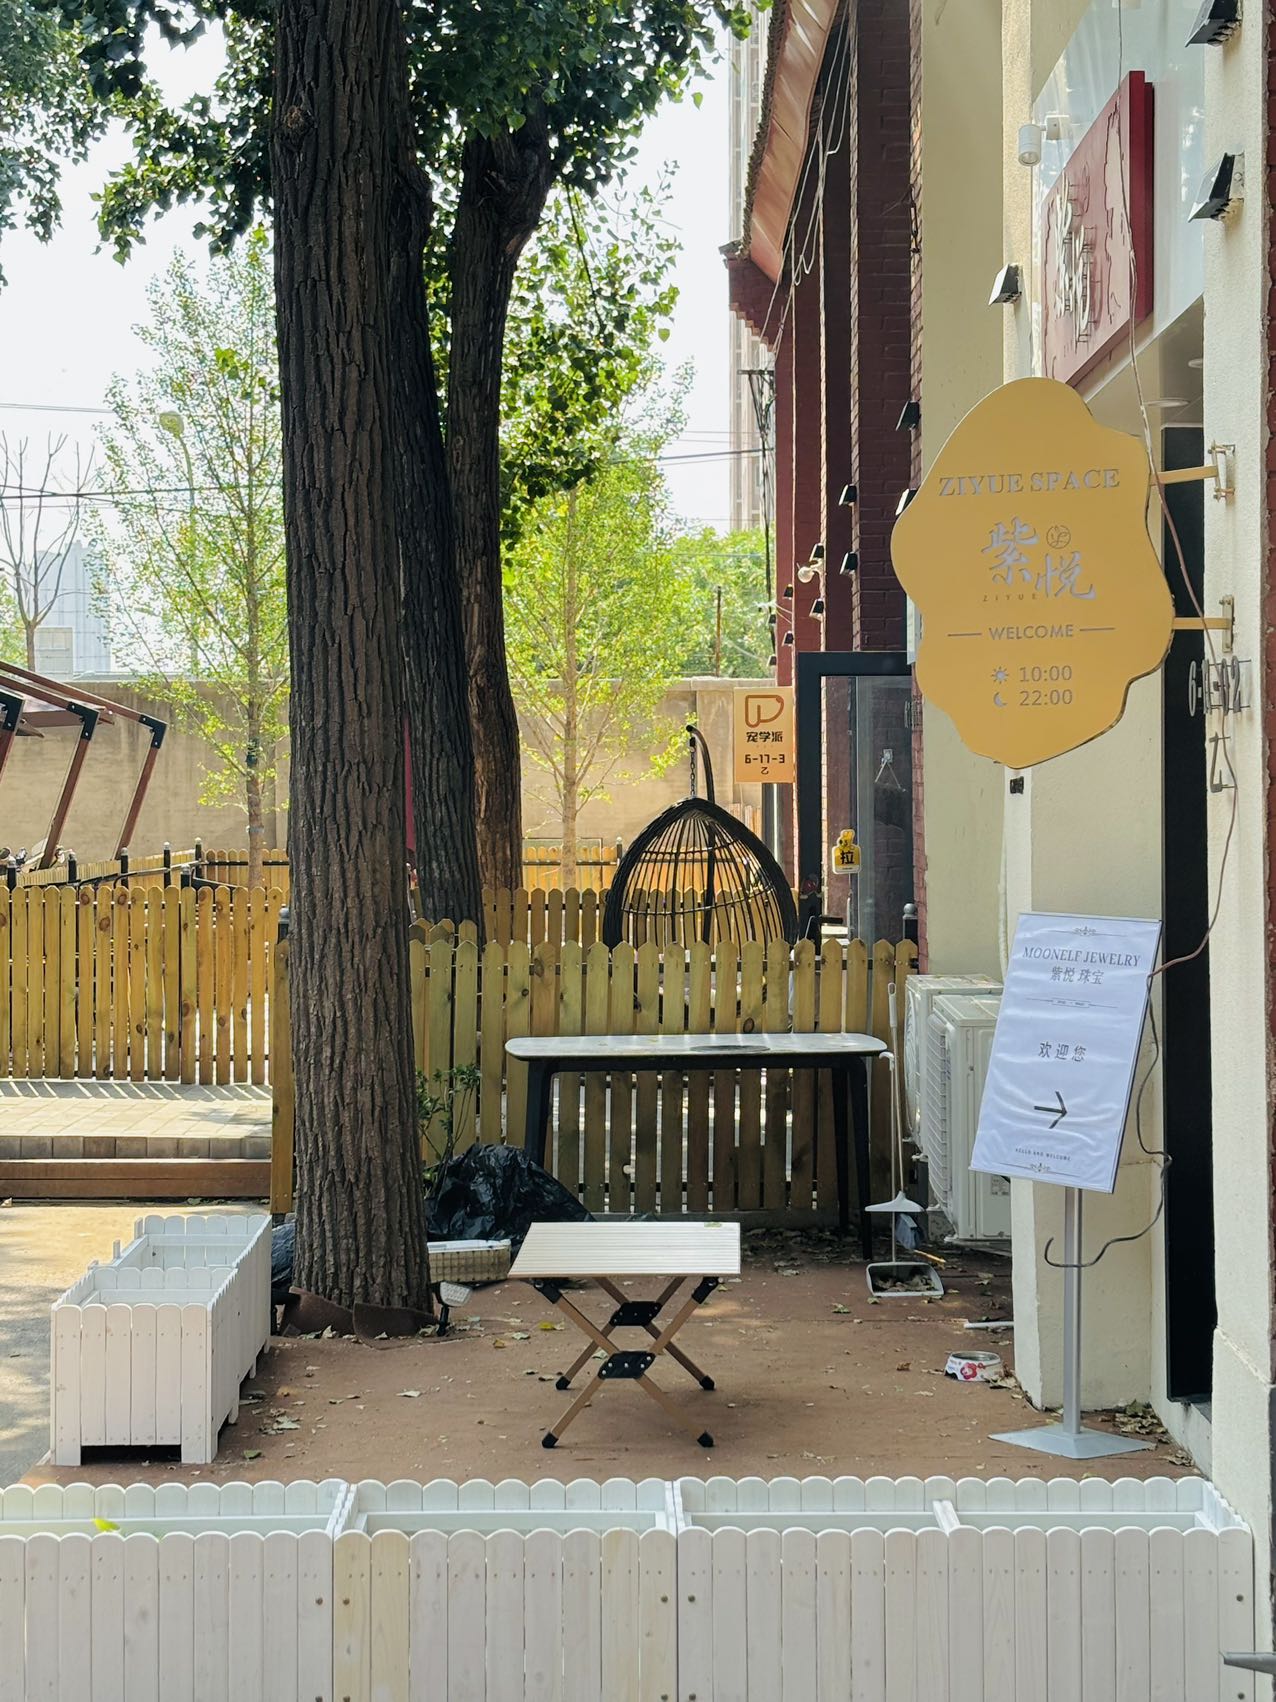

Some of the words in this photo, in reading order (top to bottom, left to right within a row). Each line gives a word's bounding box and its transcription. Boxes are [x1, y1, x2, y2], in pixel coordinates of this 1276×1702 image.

[939, 473, 1024, 496] ZIYUE
[1030, 469, 1120, 492] SPACE
[983, 592, 1037, 602] ZIYUE
[989, 624, 1074, 640] WELCOME
[1019, 665, 1072, 682] 10:00
[1019, 689, 1073, 706] 22:00
[745, 753, 785, 764] 6-17-3
[840, 850, 855, 865] 拉
[1022, 946, 1083, 962] MOONELF
[1083, 951, 1142, 967] JEWELRY
[1038, 1041, 1087, 1062] 欢迎您
